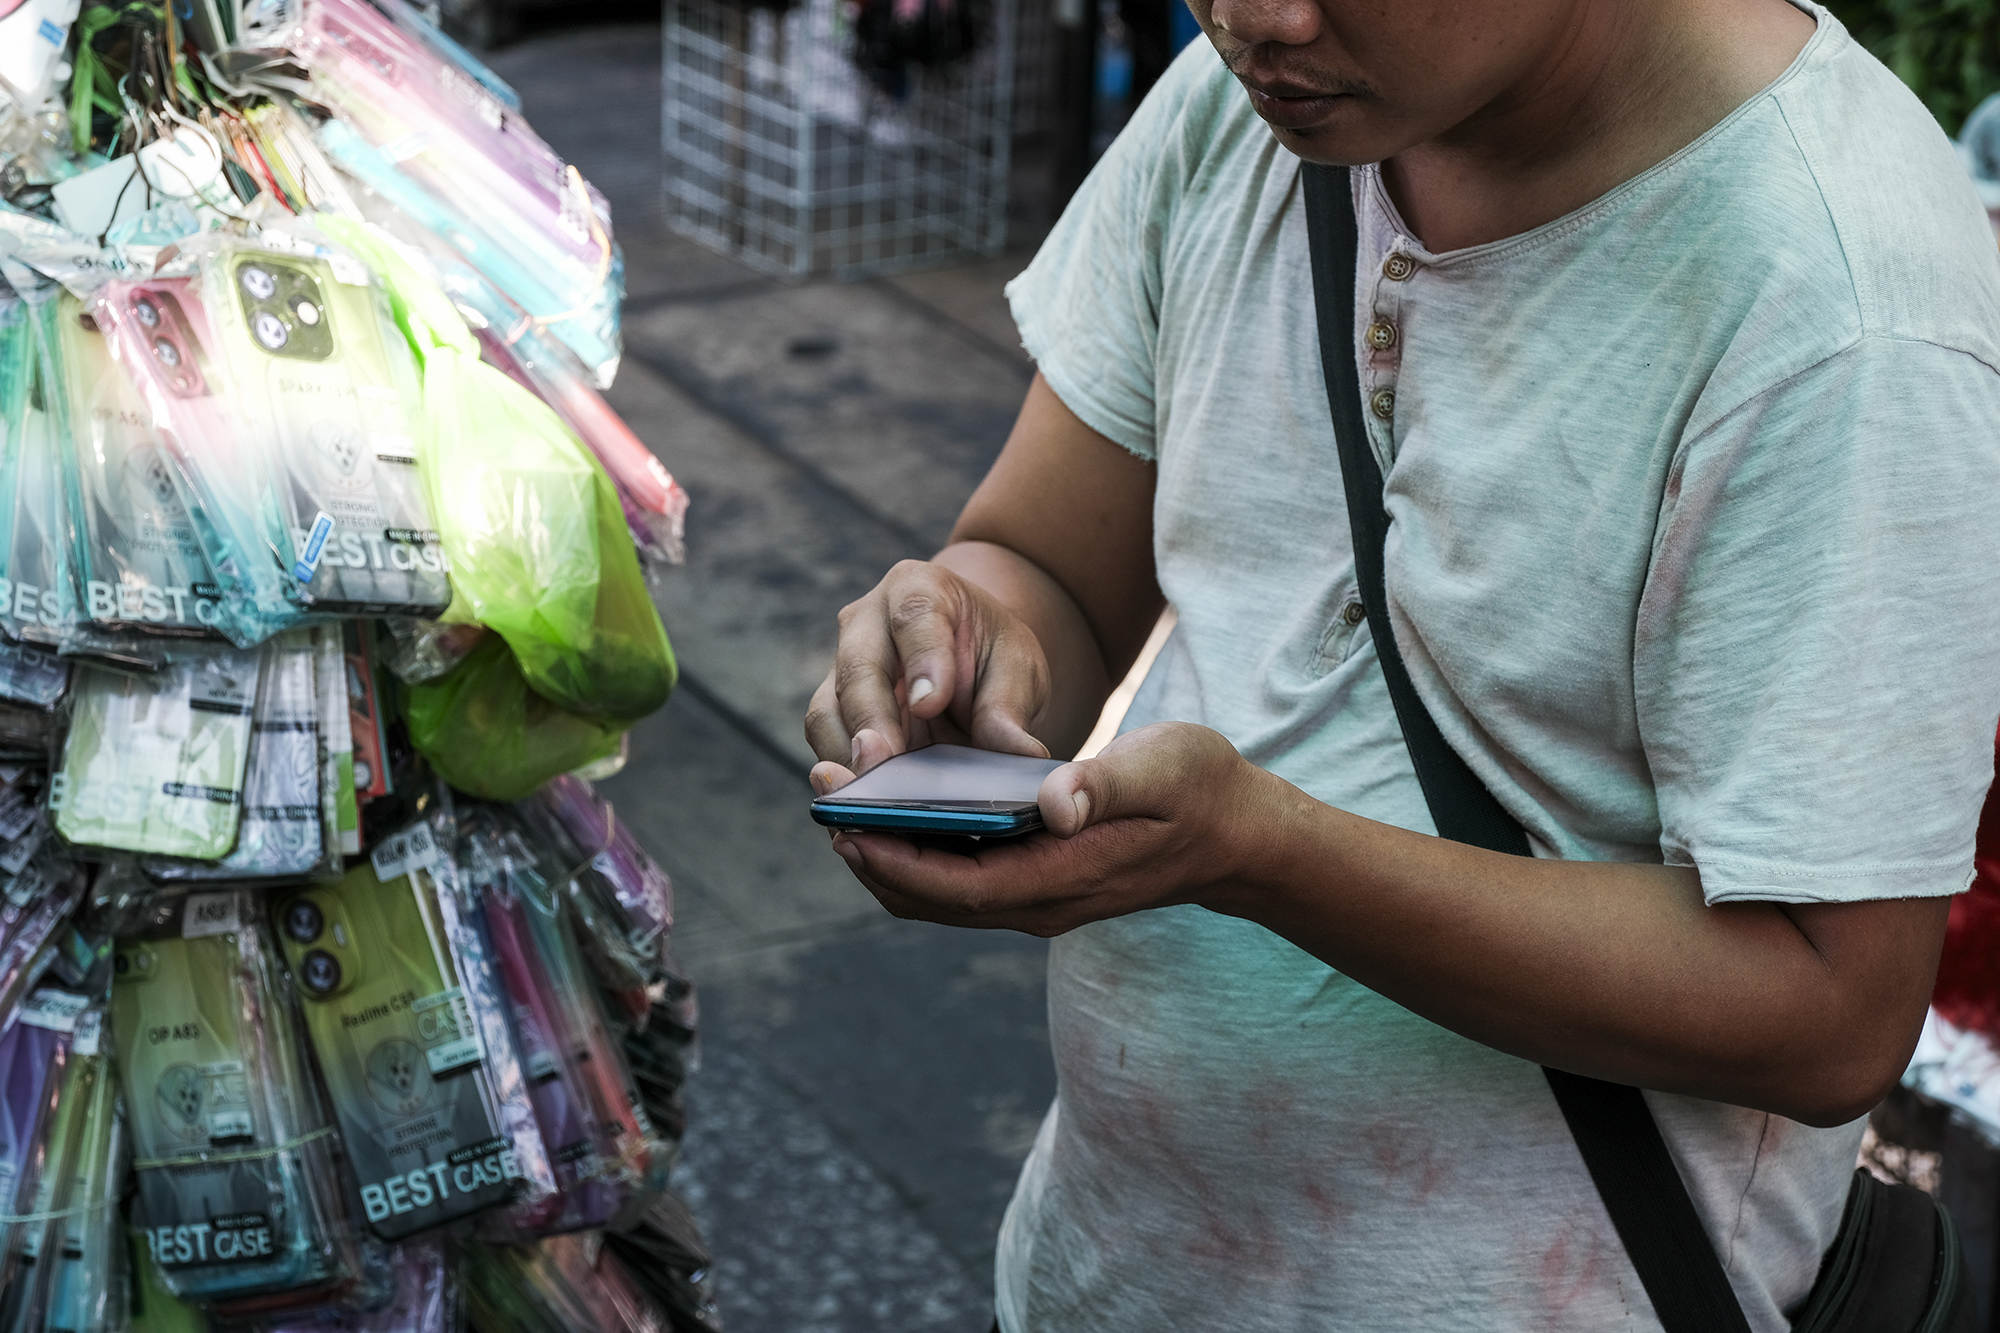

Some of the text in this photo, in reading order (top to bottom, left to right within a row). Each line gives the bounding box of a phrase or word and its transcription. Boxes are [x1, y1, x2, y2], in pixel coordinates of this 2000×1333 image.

[0, 577, 58, 628] BES
[87, 580, 189, 624] BEST
[340, 1001, 391, 1030] Realme
[394, 1115, 438, 1142] STRONG
[359, 1160, 451, 1224] BEST
[453, 1149, 519, 1194] CASE
[213, 1226, 274, 1260] CASE
